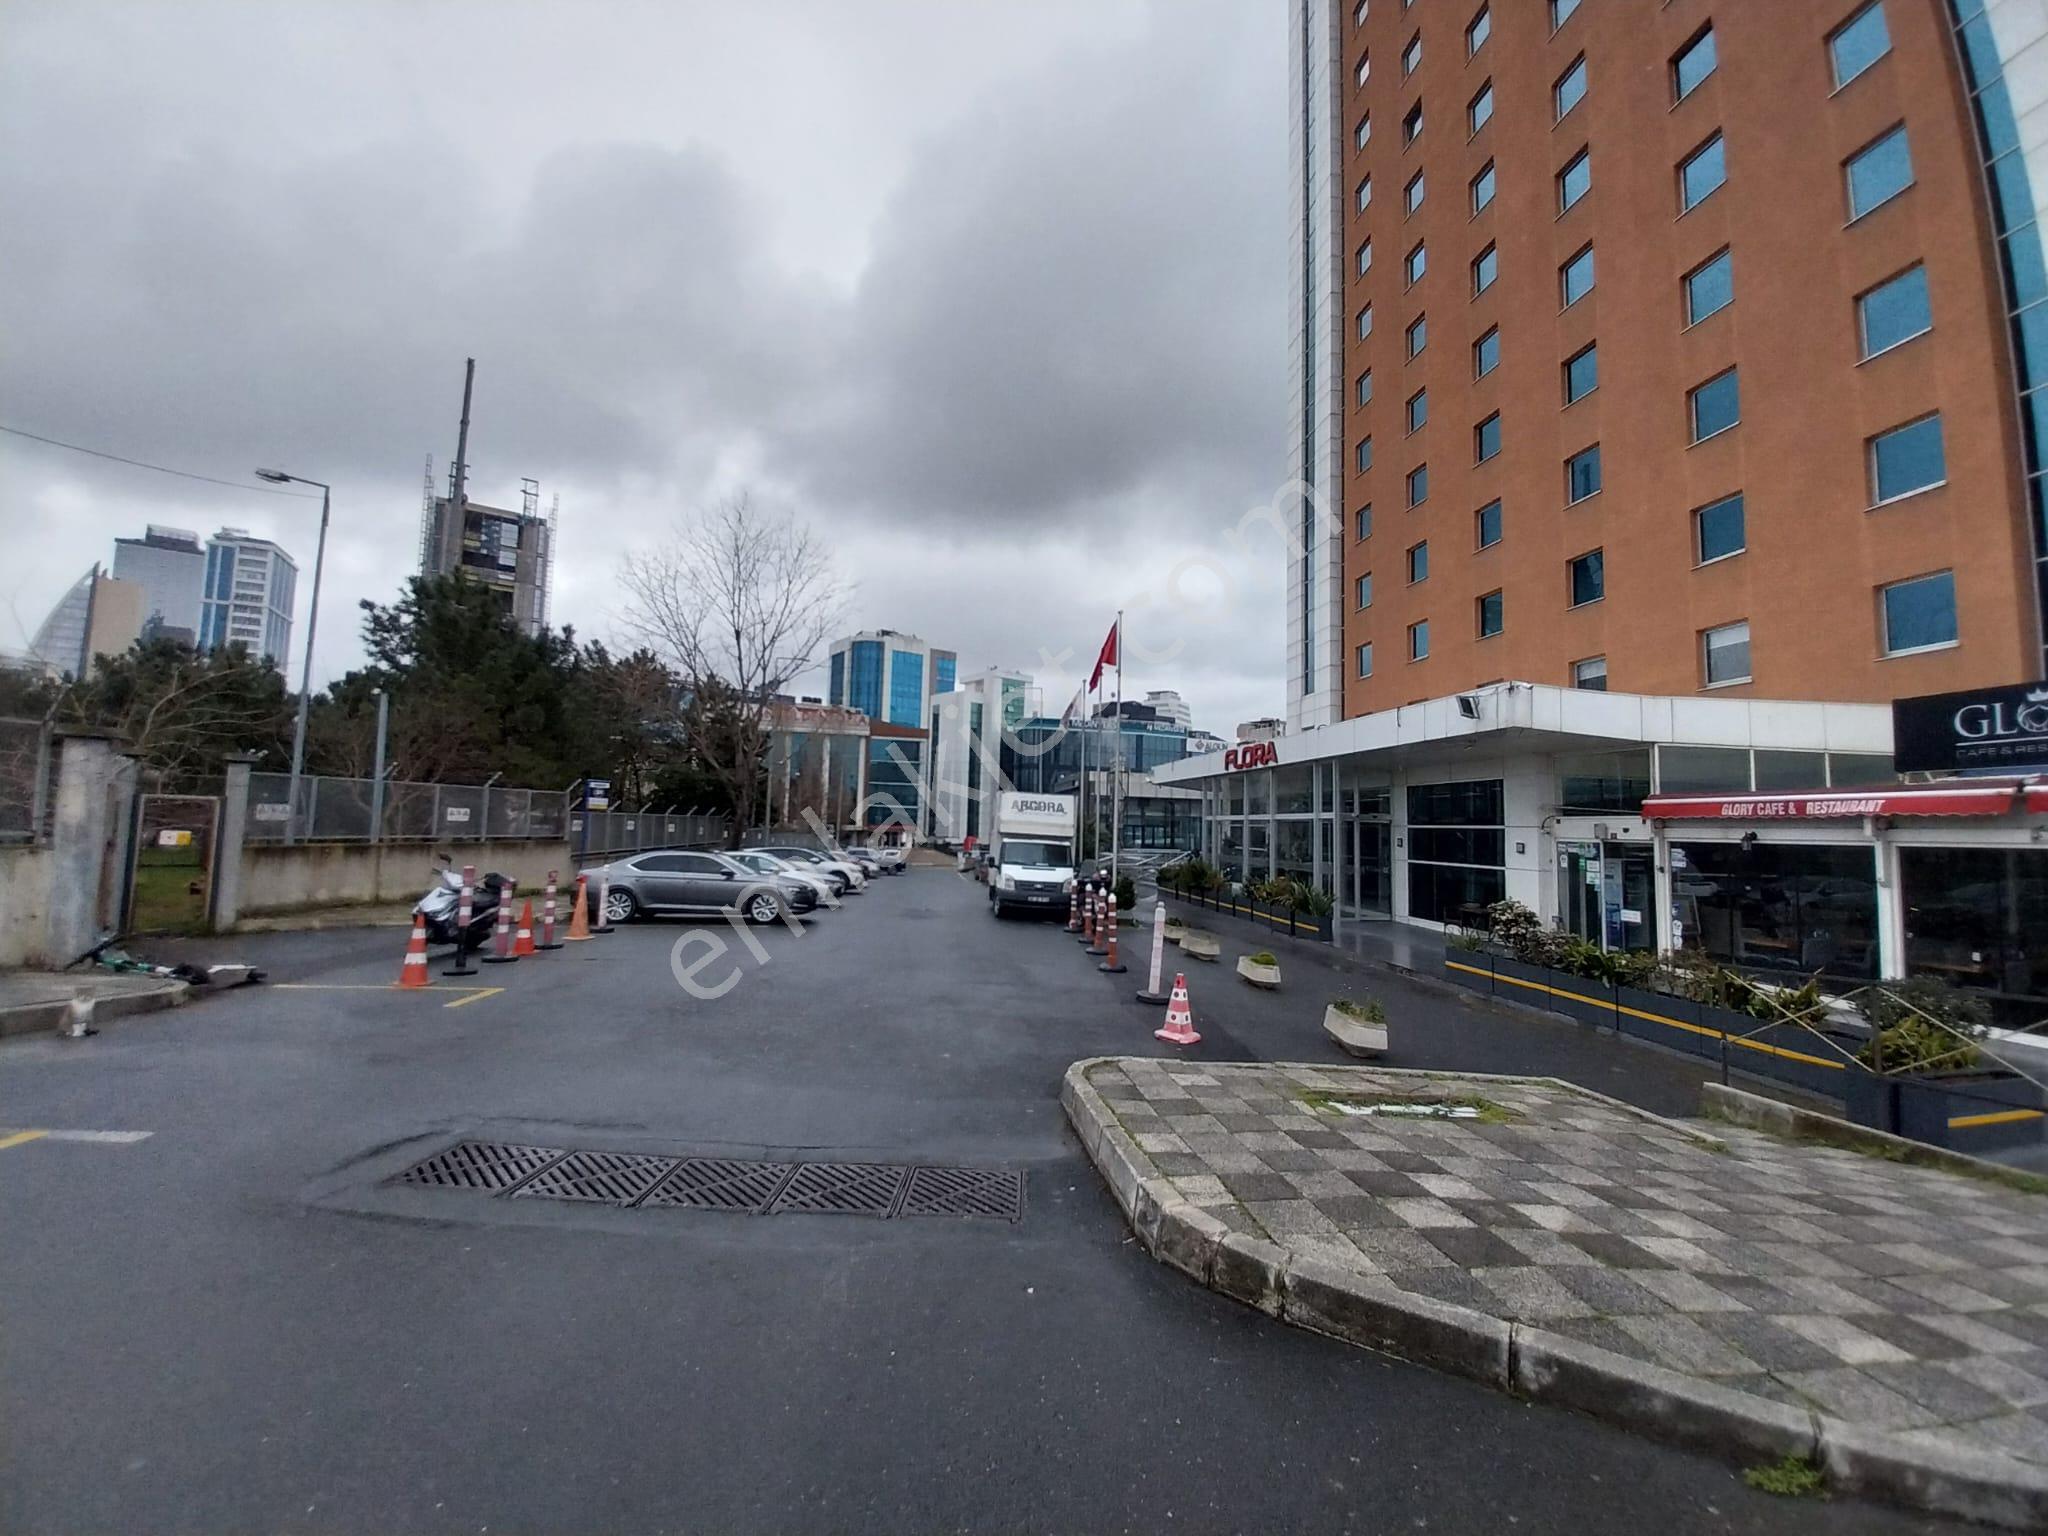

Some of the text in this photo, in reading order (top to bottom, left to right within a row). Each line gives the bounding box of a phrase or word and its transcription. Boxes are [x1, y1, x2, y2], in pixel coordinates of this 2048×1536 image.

[1224, 741, 1279, 771] FLORA
[1956, 747, 1997, 758] CAFE
[1721, 800, 1886, 816] GLORY CAFE & RESTAURANT
